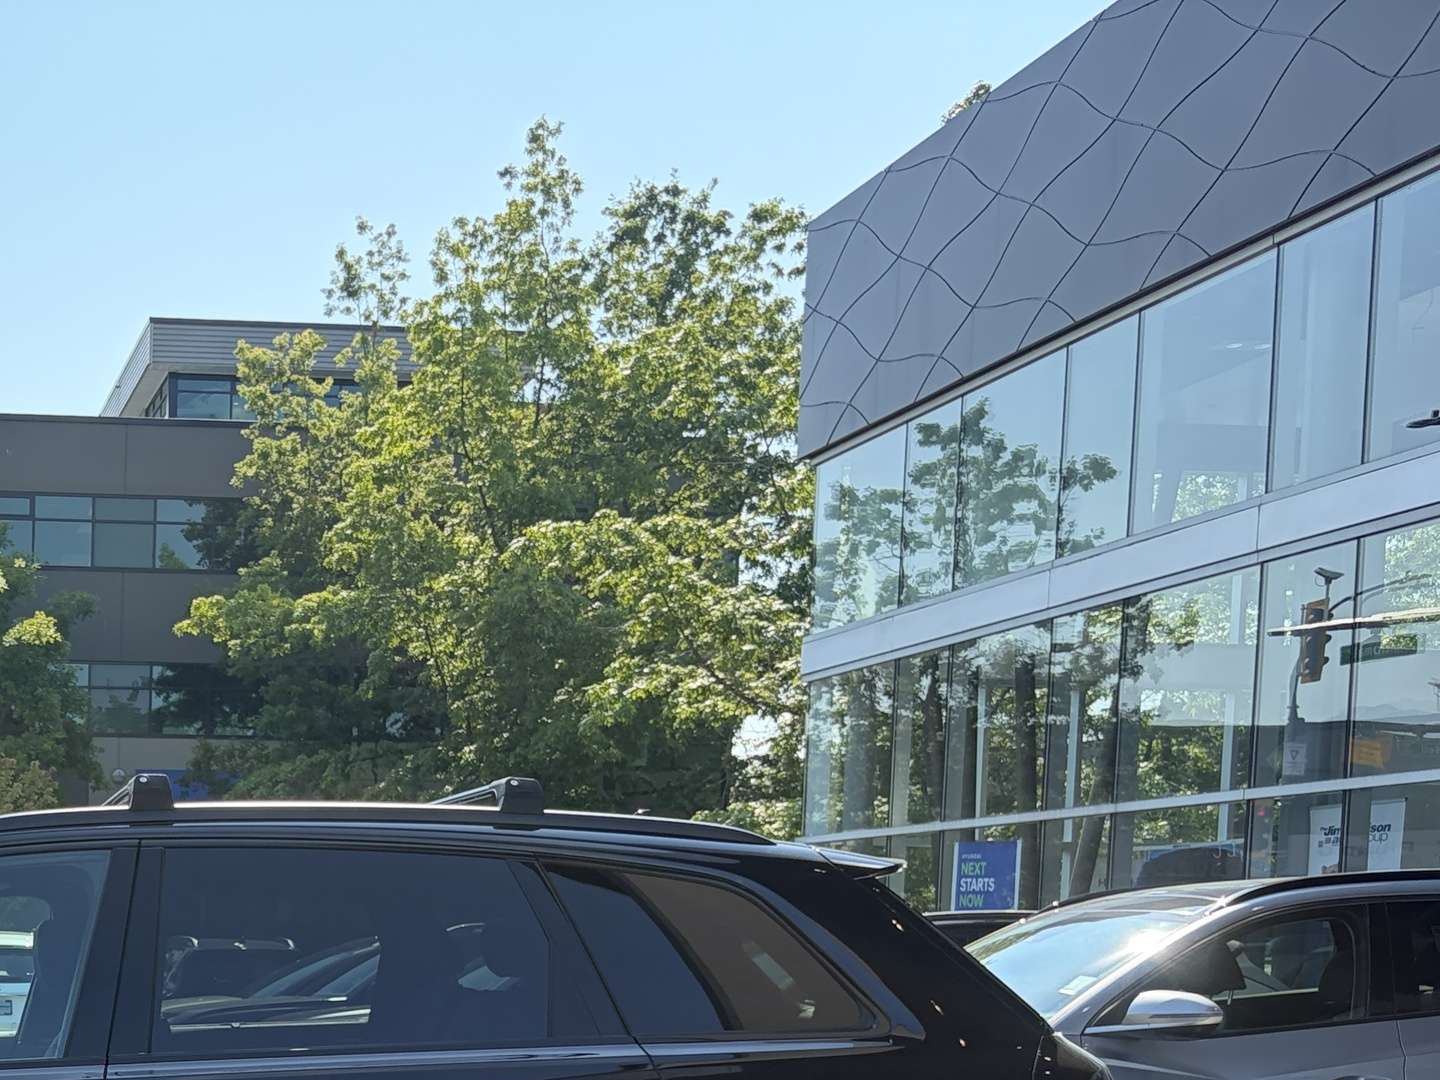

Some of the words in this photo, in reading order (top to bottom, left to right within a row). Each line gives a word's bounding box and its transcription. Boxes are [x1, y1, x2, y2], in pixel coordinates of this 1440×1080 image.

[961, 862, 987, 876] NEXT
[960, 878, 995, 892] STARTS
[959, 894, 985, 907] NOW
